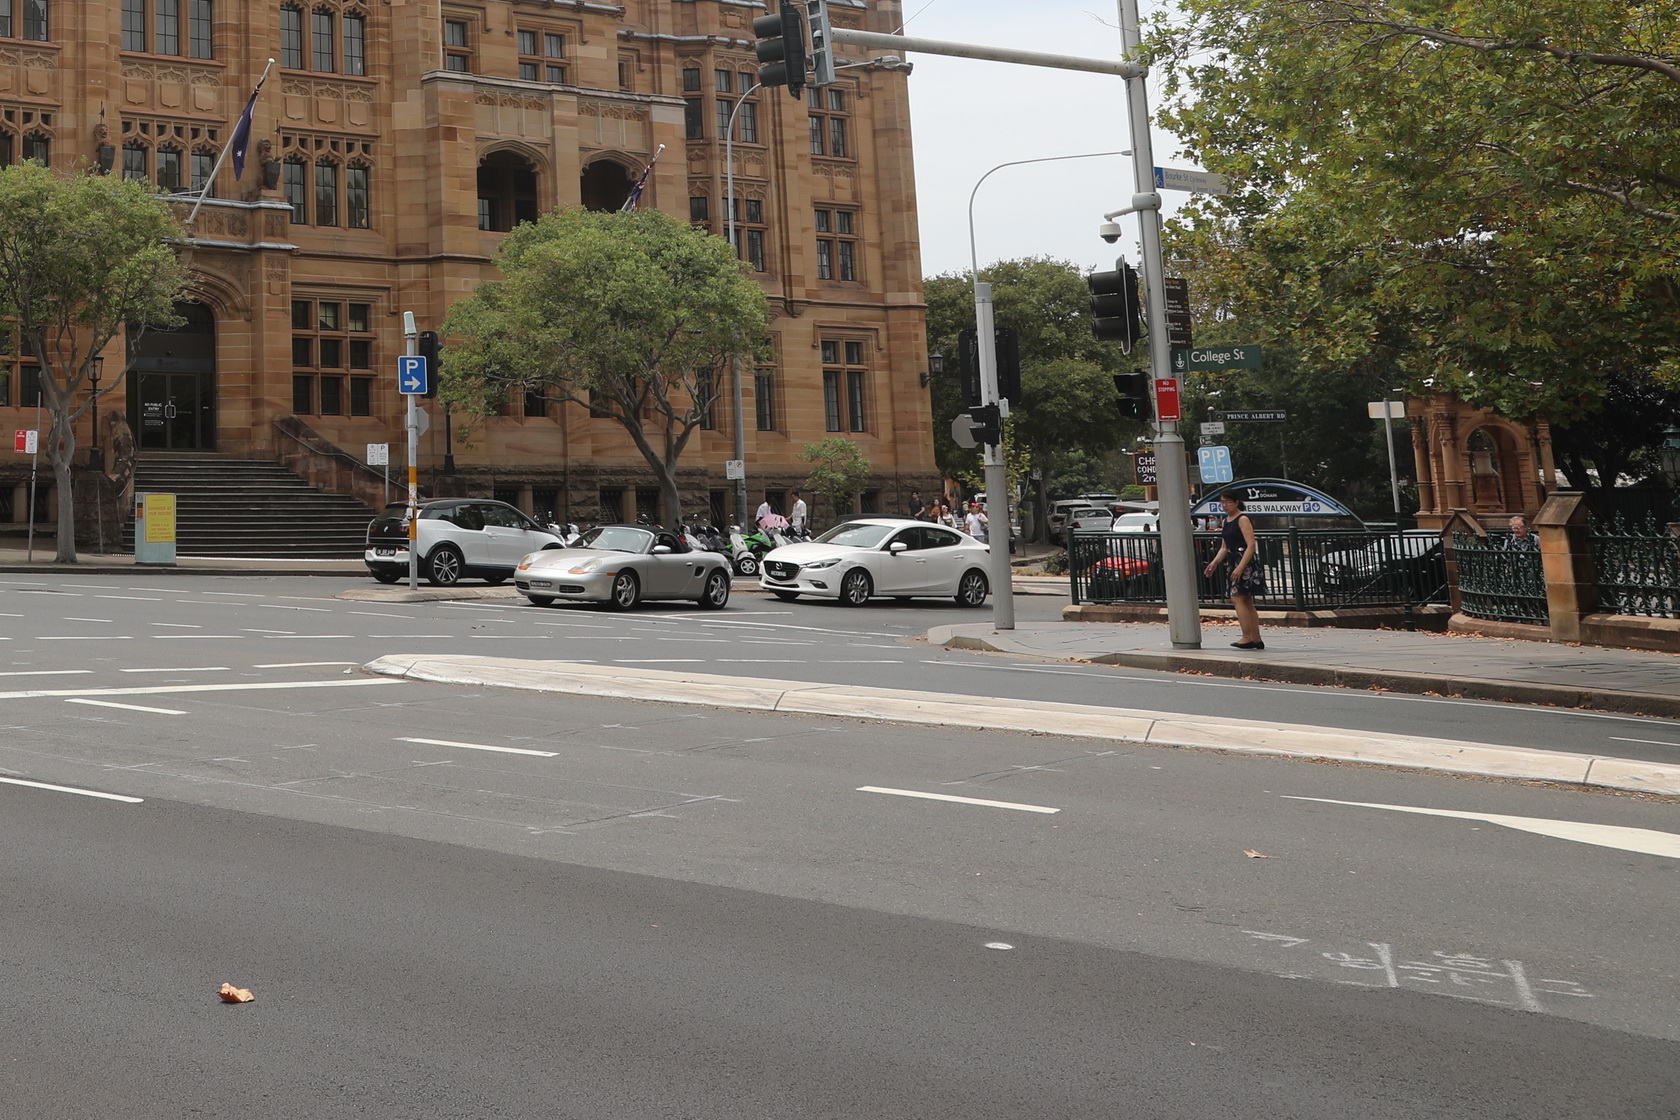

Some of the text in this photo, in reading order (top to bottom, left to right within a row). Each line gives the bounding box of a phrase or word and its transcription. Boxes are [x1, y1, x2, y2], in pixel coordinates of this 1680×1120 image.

[1165, 172, 1182, 181] Bourke
[1183, 174, 1189, 182] St
[1191, 348, 1245, 364] College St
[406, 360, 419, 375] P
[1201, 449, 1226, 464] P P
[1137, 465, 1156, 474] COND
[1141, 473, 1156, 483] 2n
[1263, 504, 1302, 512] WALKWAY
